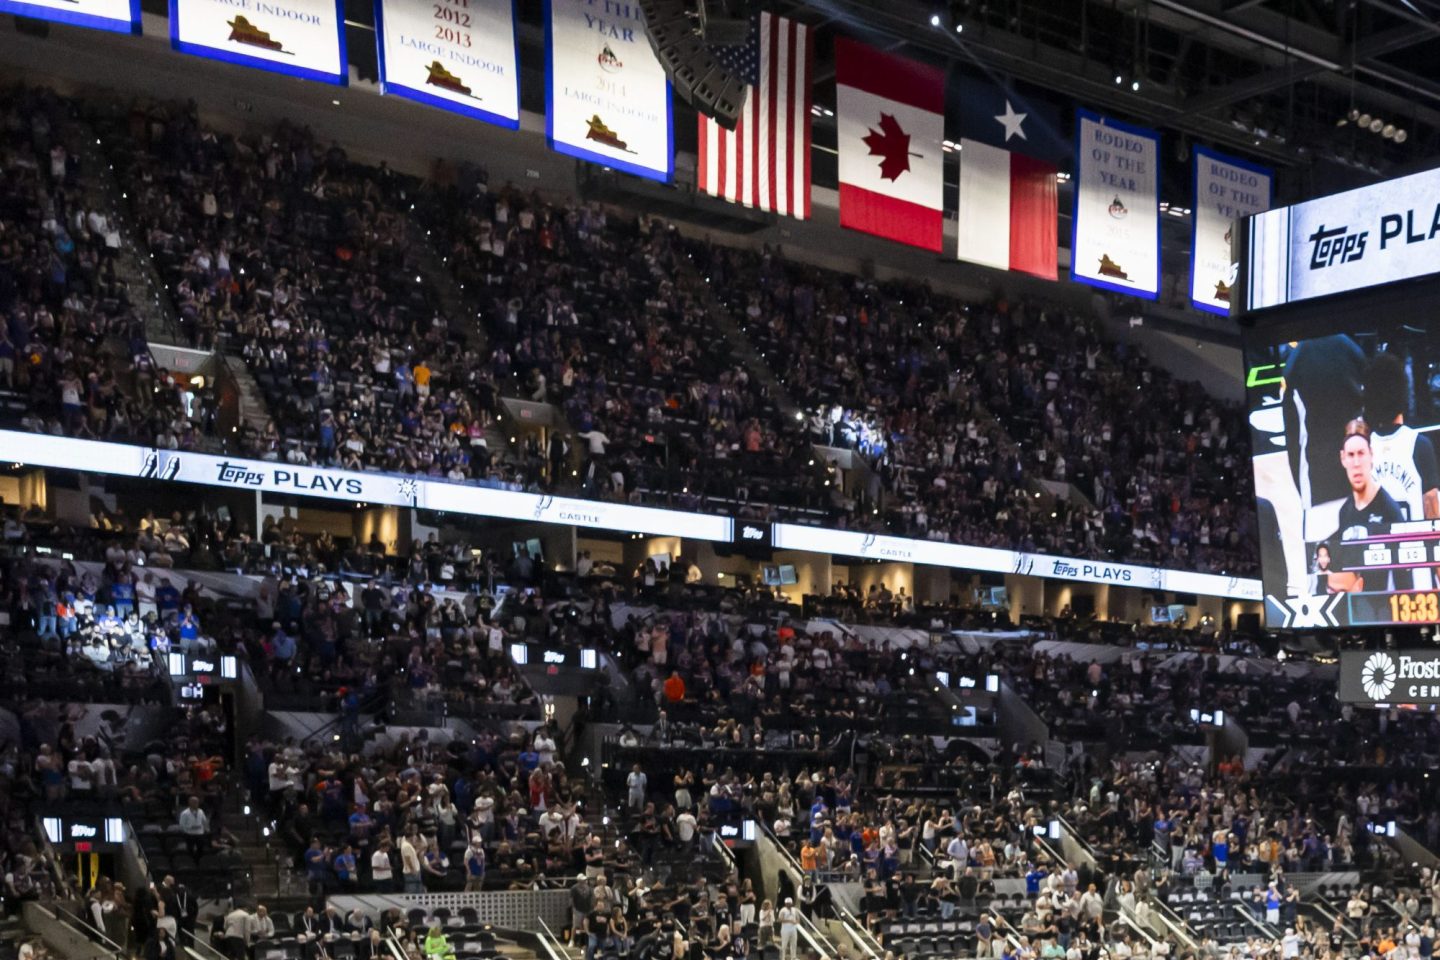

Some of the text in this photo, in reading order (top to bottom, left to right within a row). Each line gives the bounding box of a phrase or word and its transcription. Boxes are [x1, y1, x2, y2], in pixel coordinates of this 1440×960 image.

[256, 3, 321, 26] INDOOR
[433, 4, 471, 28] 2012
[584, 12, 635, 42] YEAR
[434, 24, 472, 49] 2013
[400, 35, 505, 76] LARGE INDOOR
[1094, 129, 1143, 154] RODEO
[1092, 148, 1146, 175] OF THE
[1100, 170, 1137, 192] YEAR
[1211, 163, 1259, 188] RODEO
[1209, 182, 1260, 207] OF THE
[273, 469, 363, 496] PLAYS
[559, 510, 601, 524] CASTLE
[1083, 565, 1132, 582] PLAYS
[1390, 594, 1438, 622] 13:33
[1398, 655, 1440, 679] Frost
